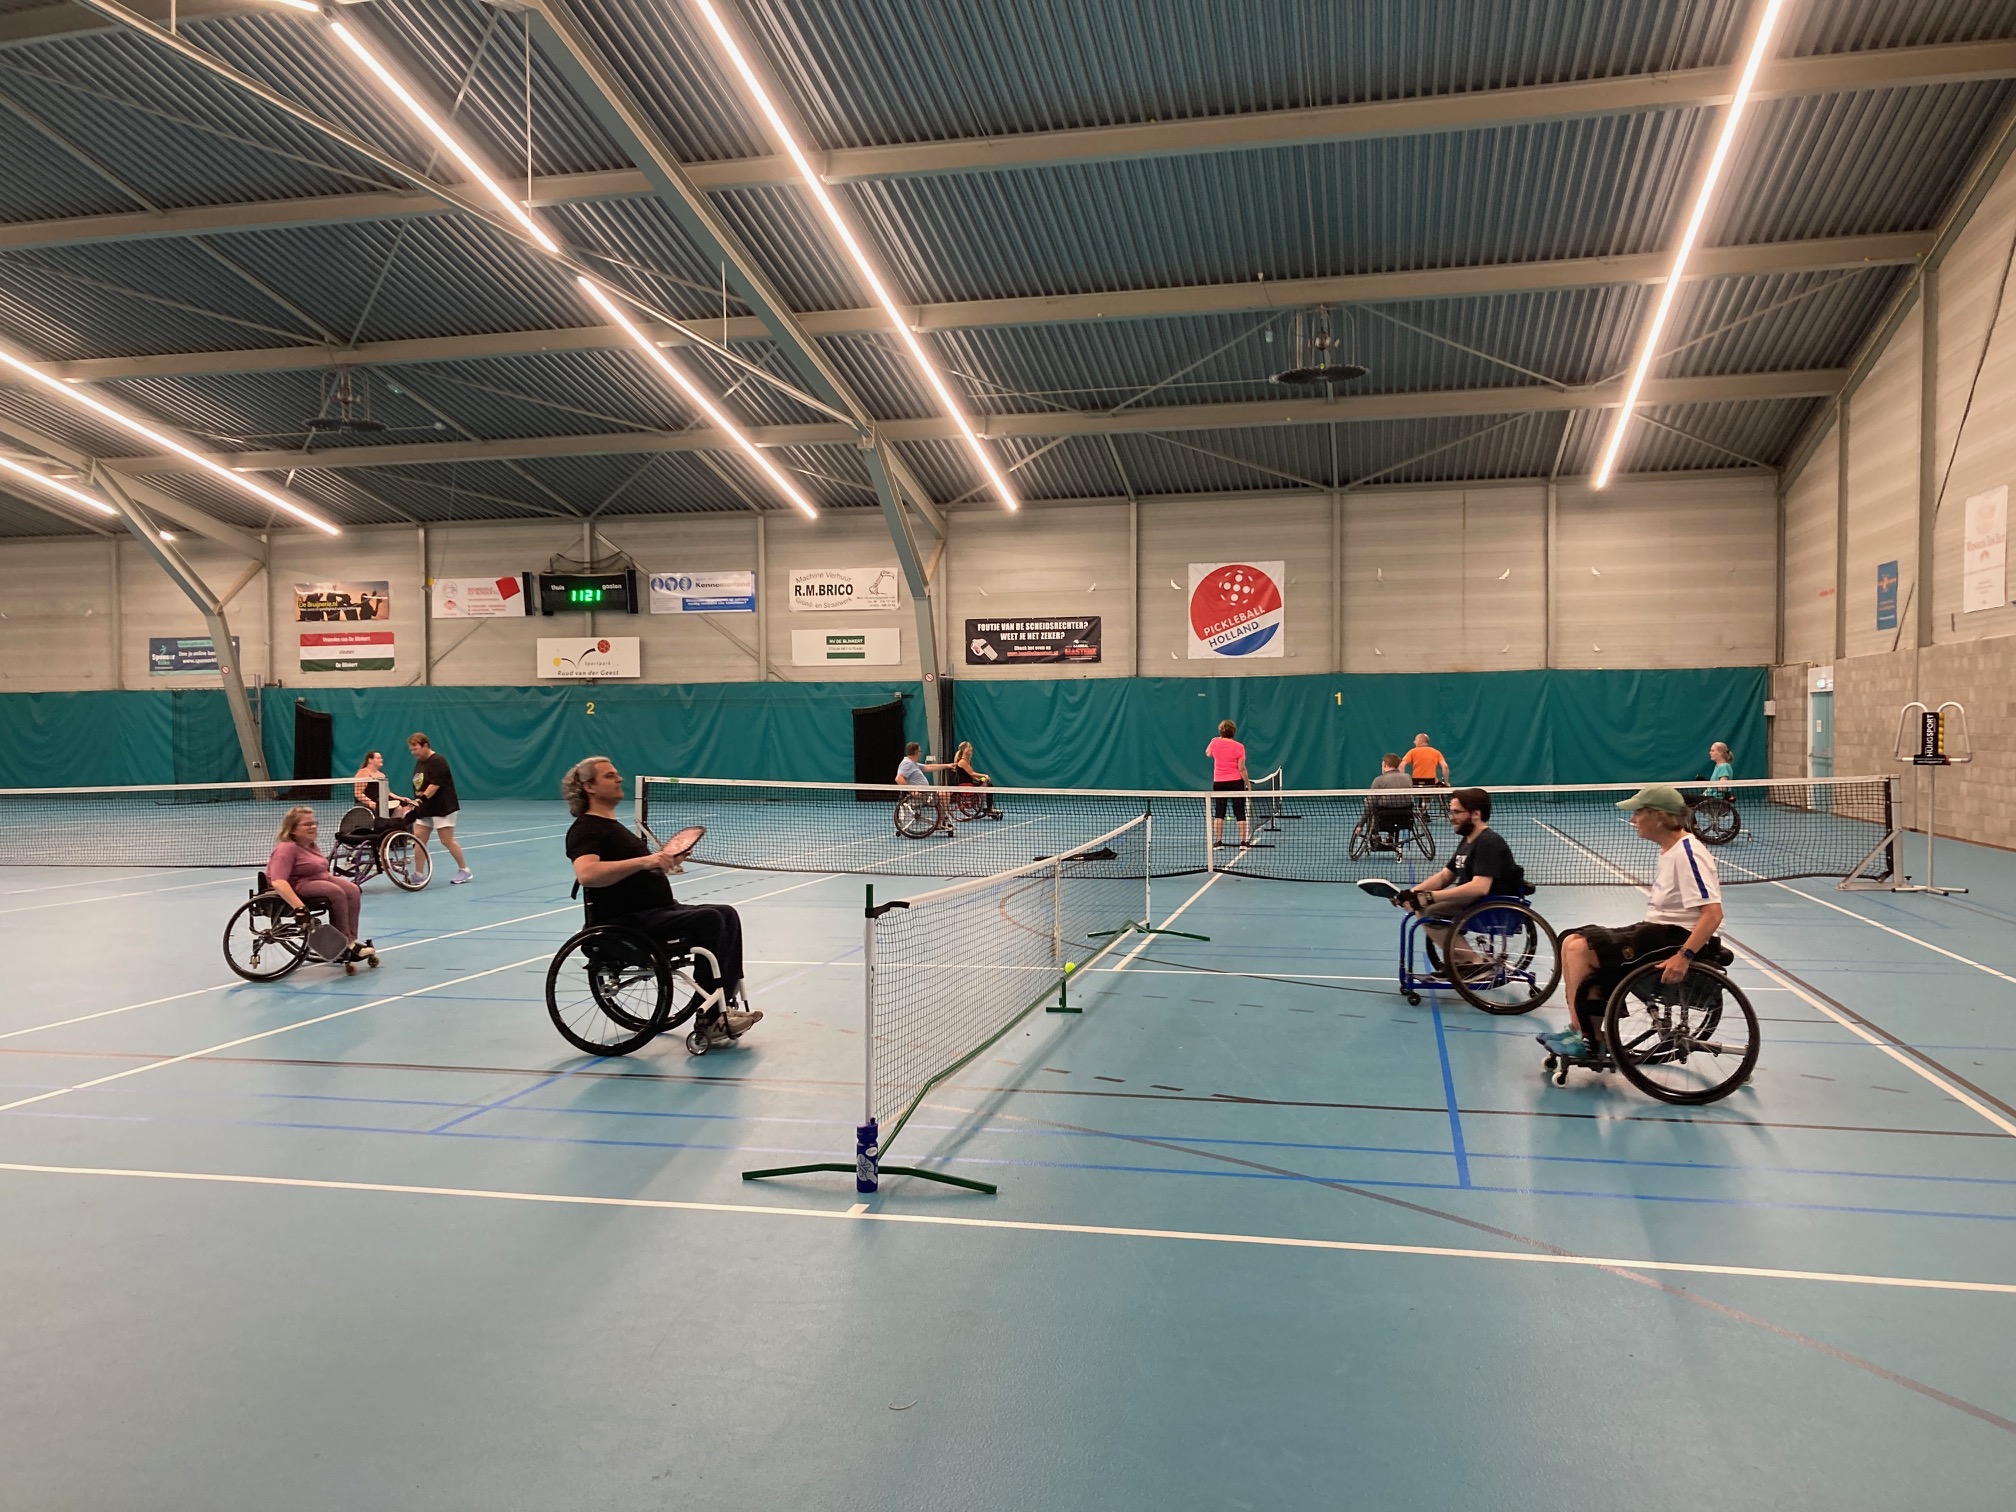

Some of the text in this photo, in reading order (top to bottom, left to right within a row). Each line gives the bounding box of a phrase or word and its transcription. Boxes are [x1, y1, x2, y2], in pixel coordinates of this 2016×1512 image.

[796, 571, 852, 583] Machine Verhuur
[795, 584, 854, 597] R.M.BRICO
[824, 597, 853, 608] Straatwerk
[977, 621, 1089, 631] FOUTJE VAN DE SCHEIDSRECHTER?
[1203, 605, 1266, 636] PICKLEBALL
[1000, 631, 1066, 640] WEET JE HET ZEKER?
[1208, 621, 1259, 648] HOLLAND
[1334, 691, 1342, 706] 1
[586, 701, 595, 715] 2
